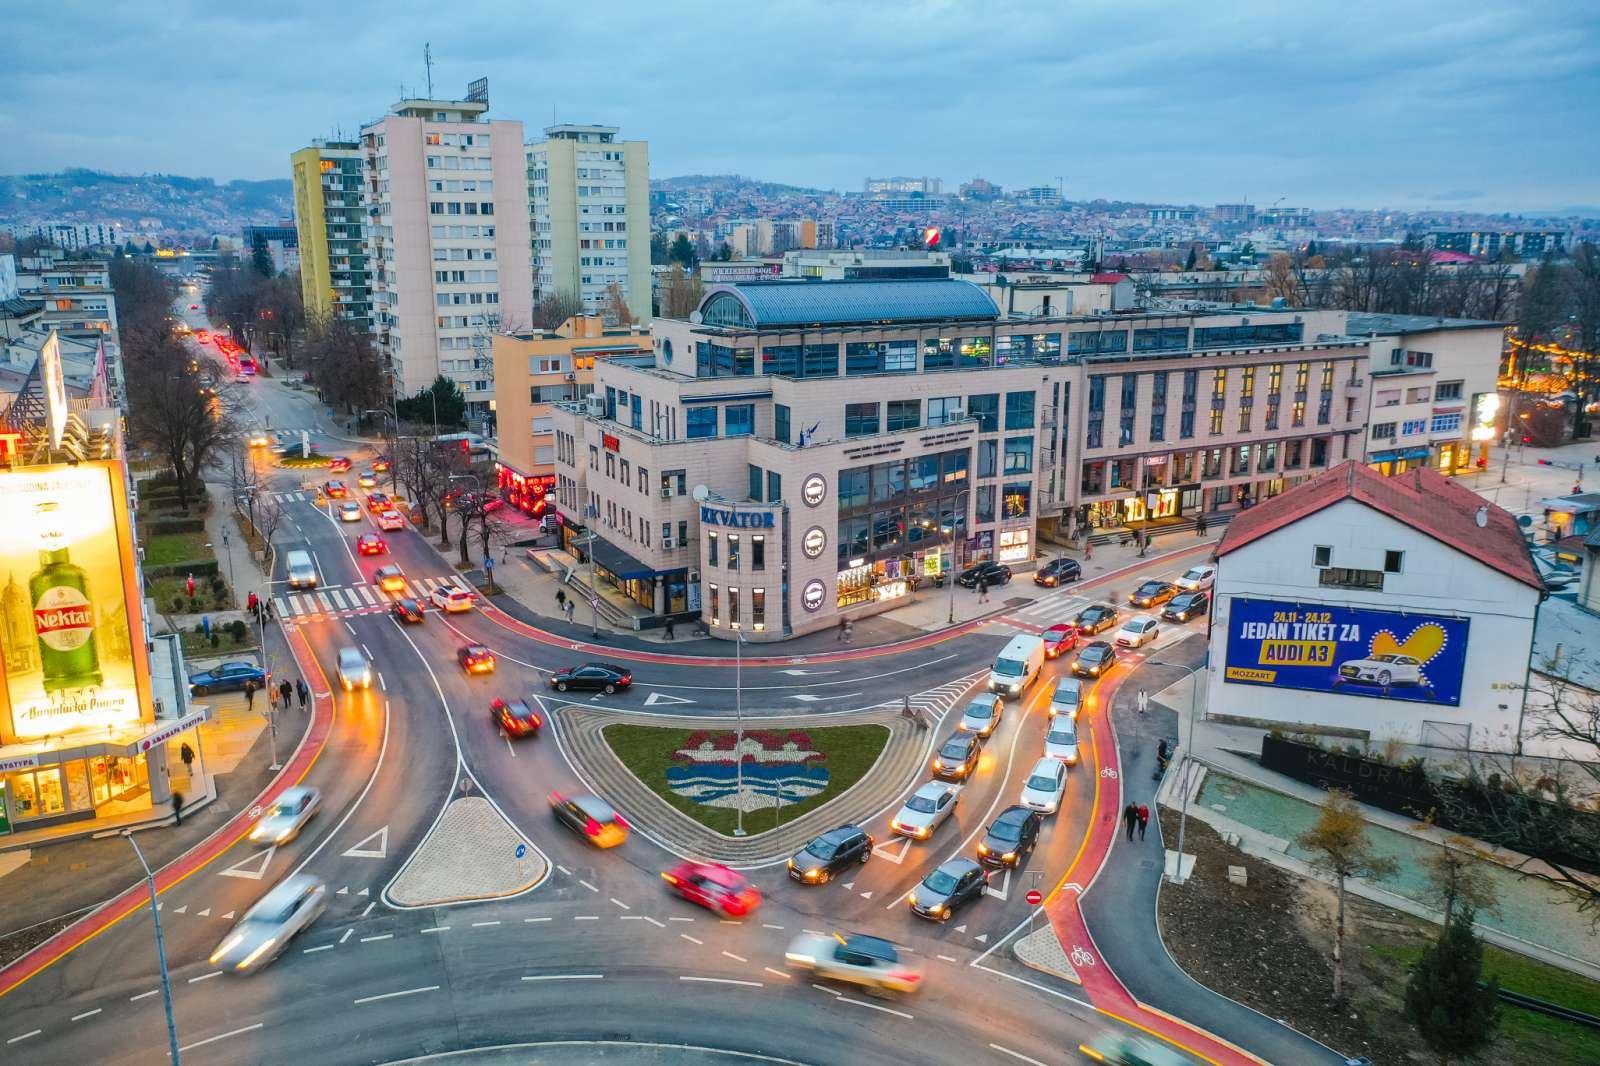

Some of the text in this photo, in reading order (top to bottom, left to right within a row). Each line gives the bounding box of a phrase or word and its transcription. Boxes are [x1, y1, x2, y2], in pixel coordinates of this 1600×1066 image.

[701, 506, 776, 529] EKVATOR
[36, 610, 92, 629] Nektar
[1273, 611, 1297, 622] 24.11
[1305, 612, 1331, 623] 24.12
[1240, 622, 1360, 642] JEDAN TIKET ZA
[1265, 644, 1329, 662] AUDI A3
[1232, 670, 1271, 680] MOZZART
